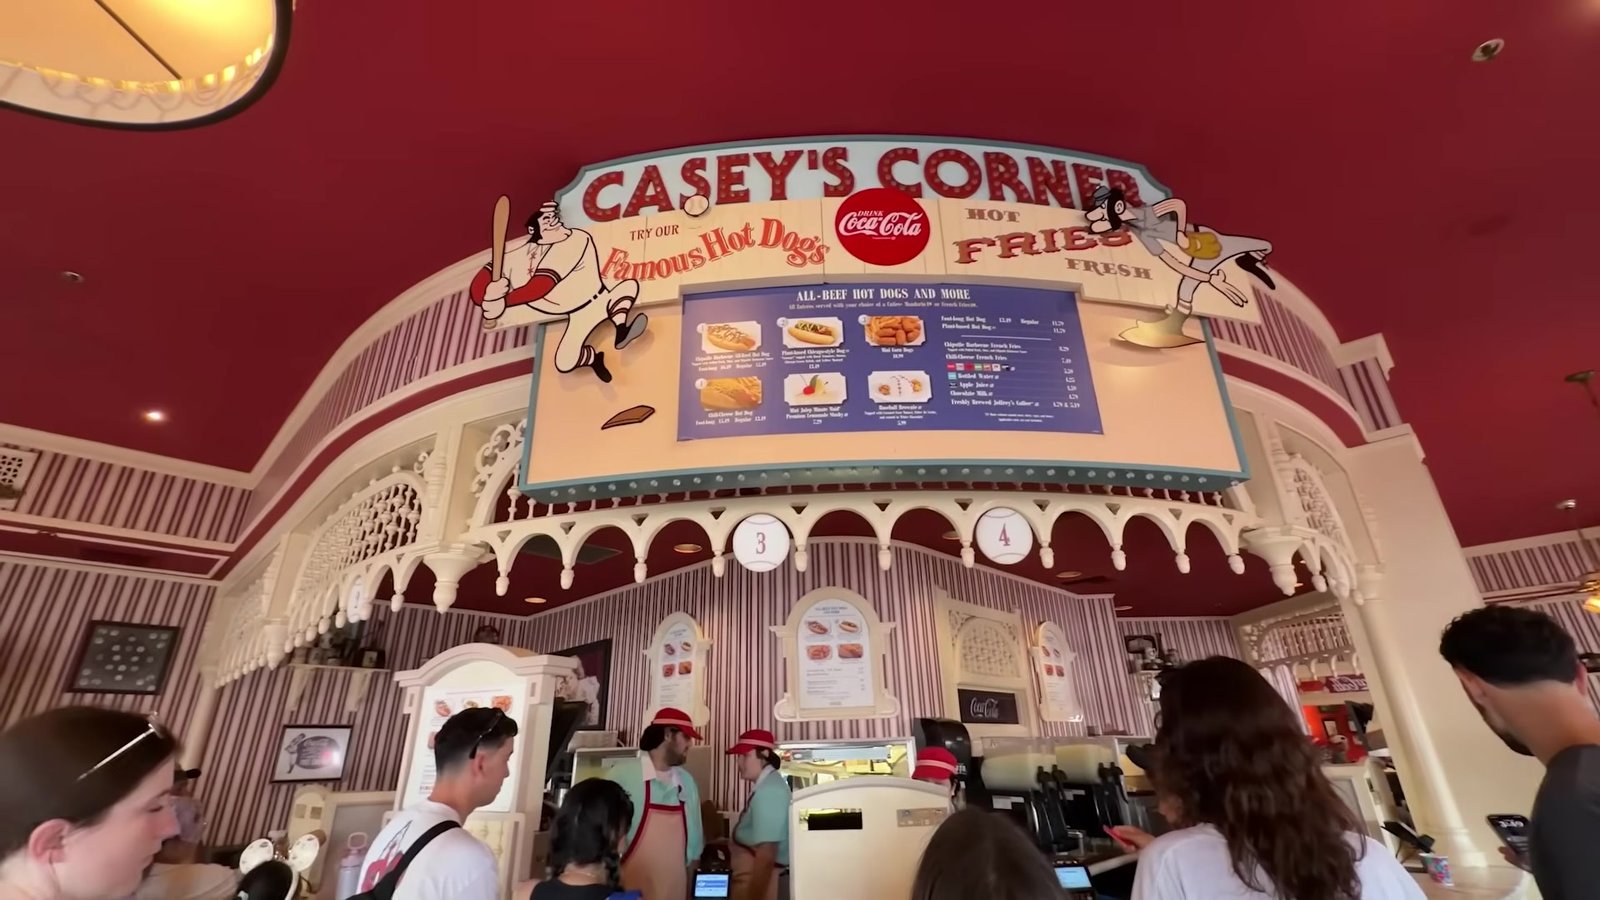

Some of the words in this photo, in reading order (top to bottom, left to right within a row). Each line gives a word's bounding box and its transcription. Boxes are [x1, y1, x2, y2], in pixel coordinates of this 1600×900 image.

[582, 146, 855, 222] CASEY'S
[877, 147, 1145, 211] CORNER
[838, 211, 924, 236] Coca-Cola
[965, 208, 1021, 223] HOT
[630, 226, 652, 241] TRY
[655, 224, 680, 238] OUR
[952, 225, 1133, 264] FRIES
[600, 246, 707, 282] Famous
[698, 221, 758, 262] Hot
[1064, 258, 1153, 280] FRESH
[796, 289, 848, 302] ALL-BEEF
[852, 288, 875, 300] HOT
[880, 288, 909, 299] DOGS
[913, 288, 936, 299] AND
[940, 288, 971, 300] MORE
[755, 531, 766, 555] 3
[998, 523, 1010, 547] 4
